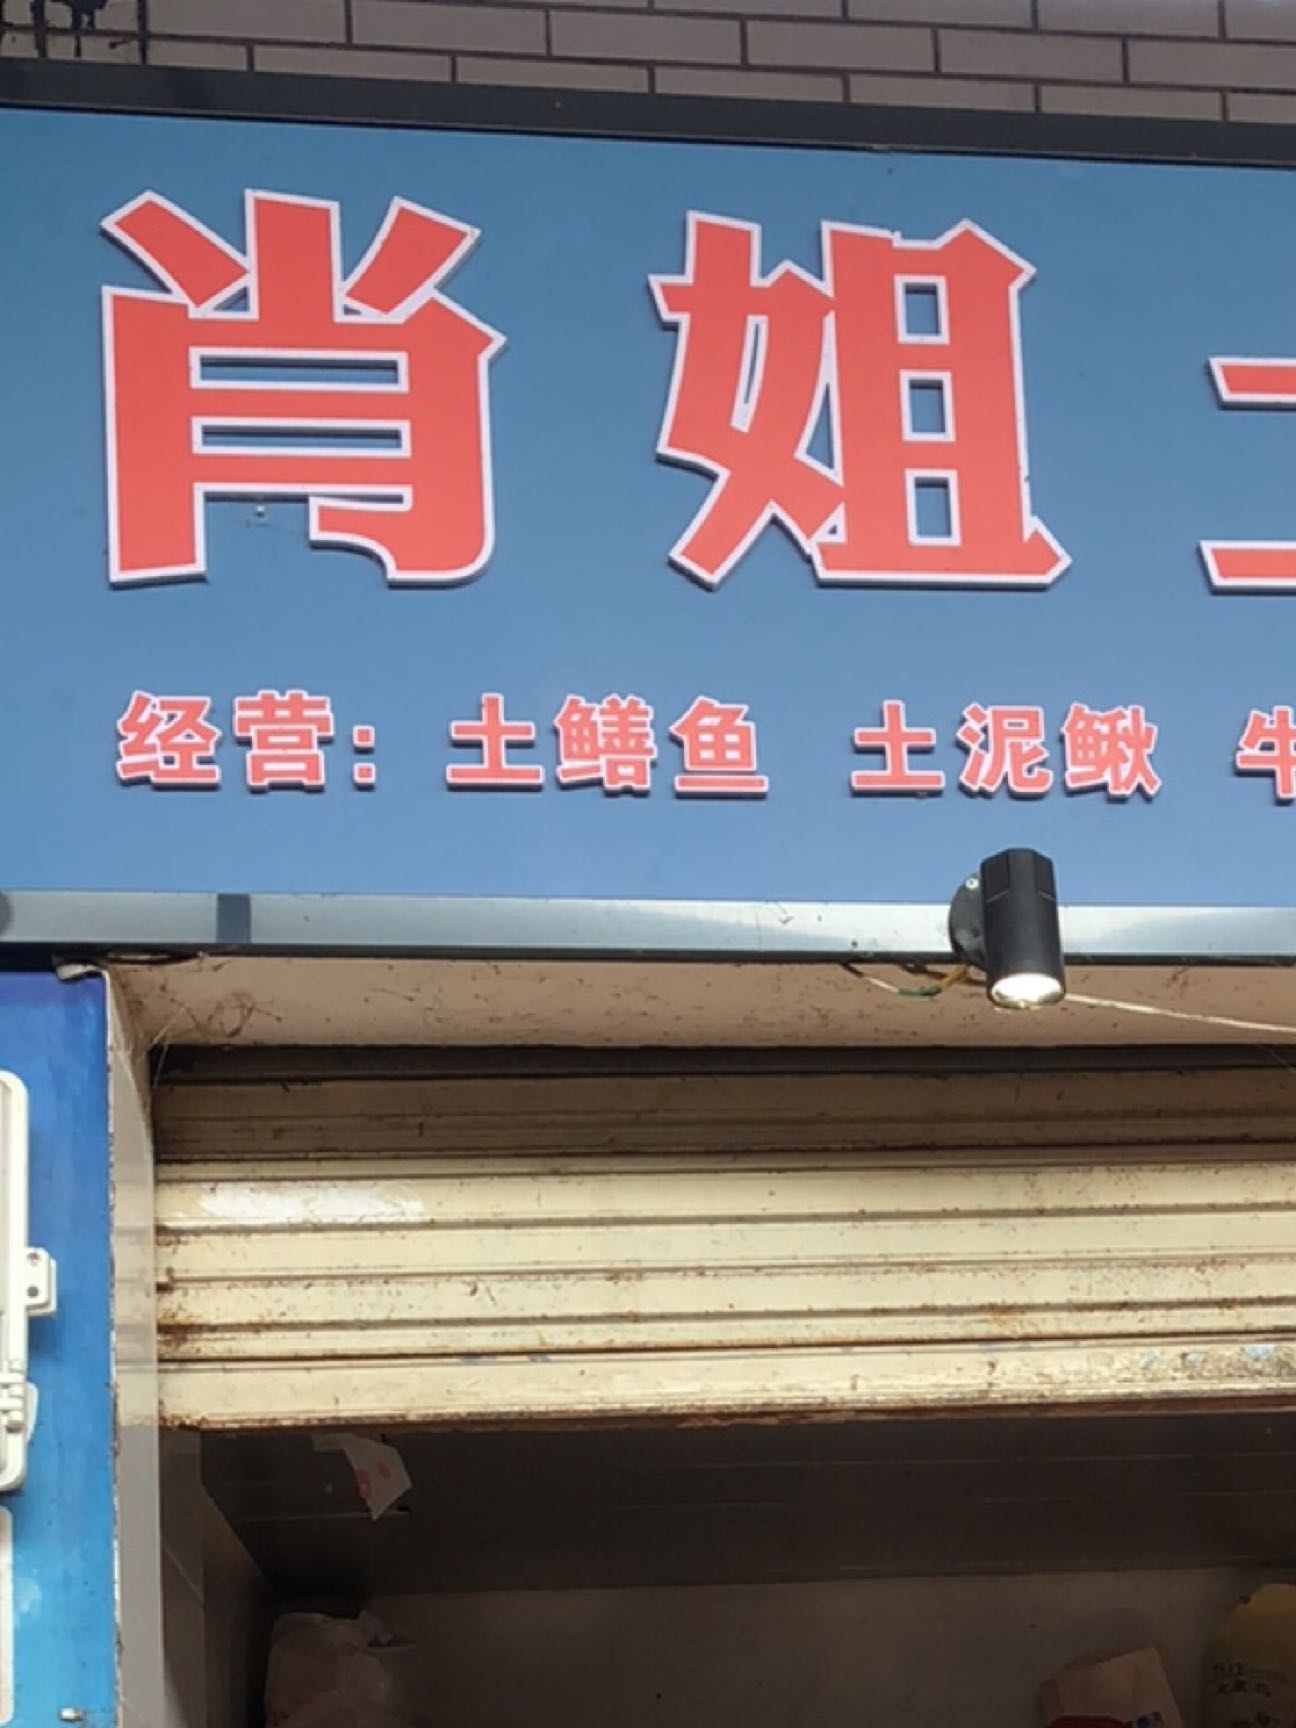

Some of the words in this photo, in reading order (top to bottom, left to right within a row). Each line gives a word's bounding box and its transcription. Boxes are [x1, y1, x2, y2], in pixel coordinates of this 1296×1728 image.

[446, 692, 769, 797] 土鳝鱼
[851, 699, 1164, 796] 土泥鳅
